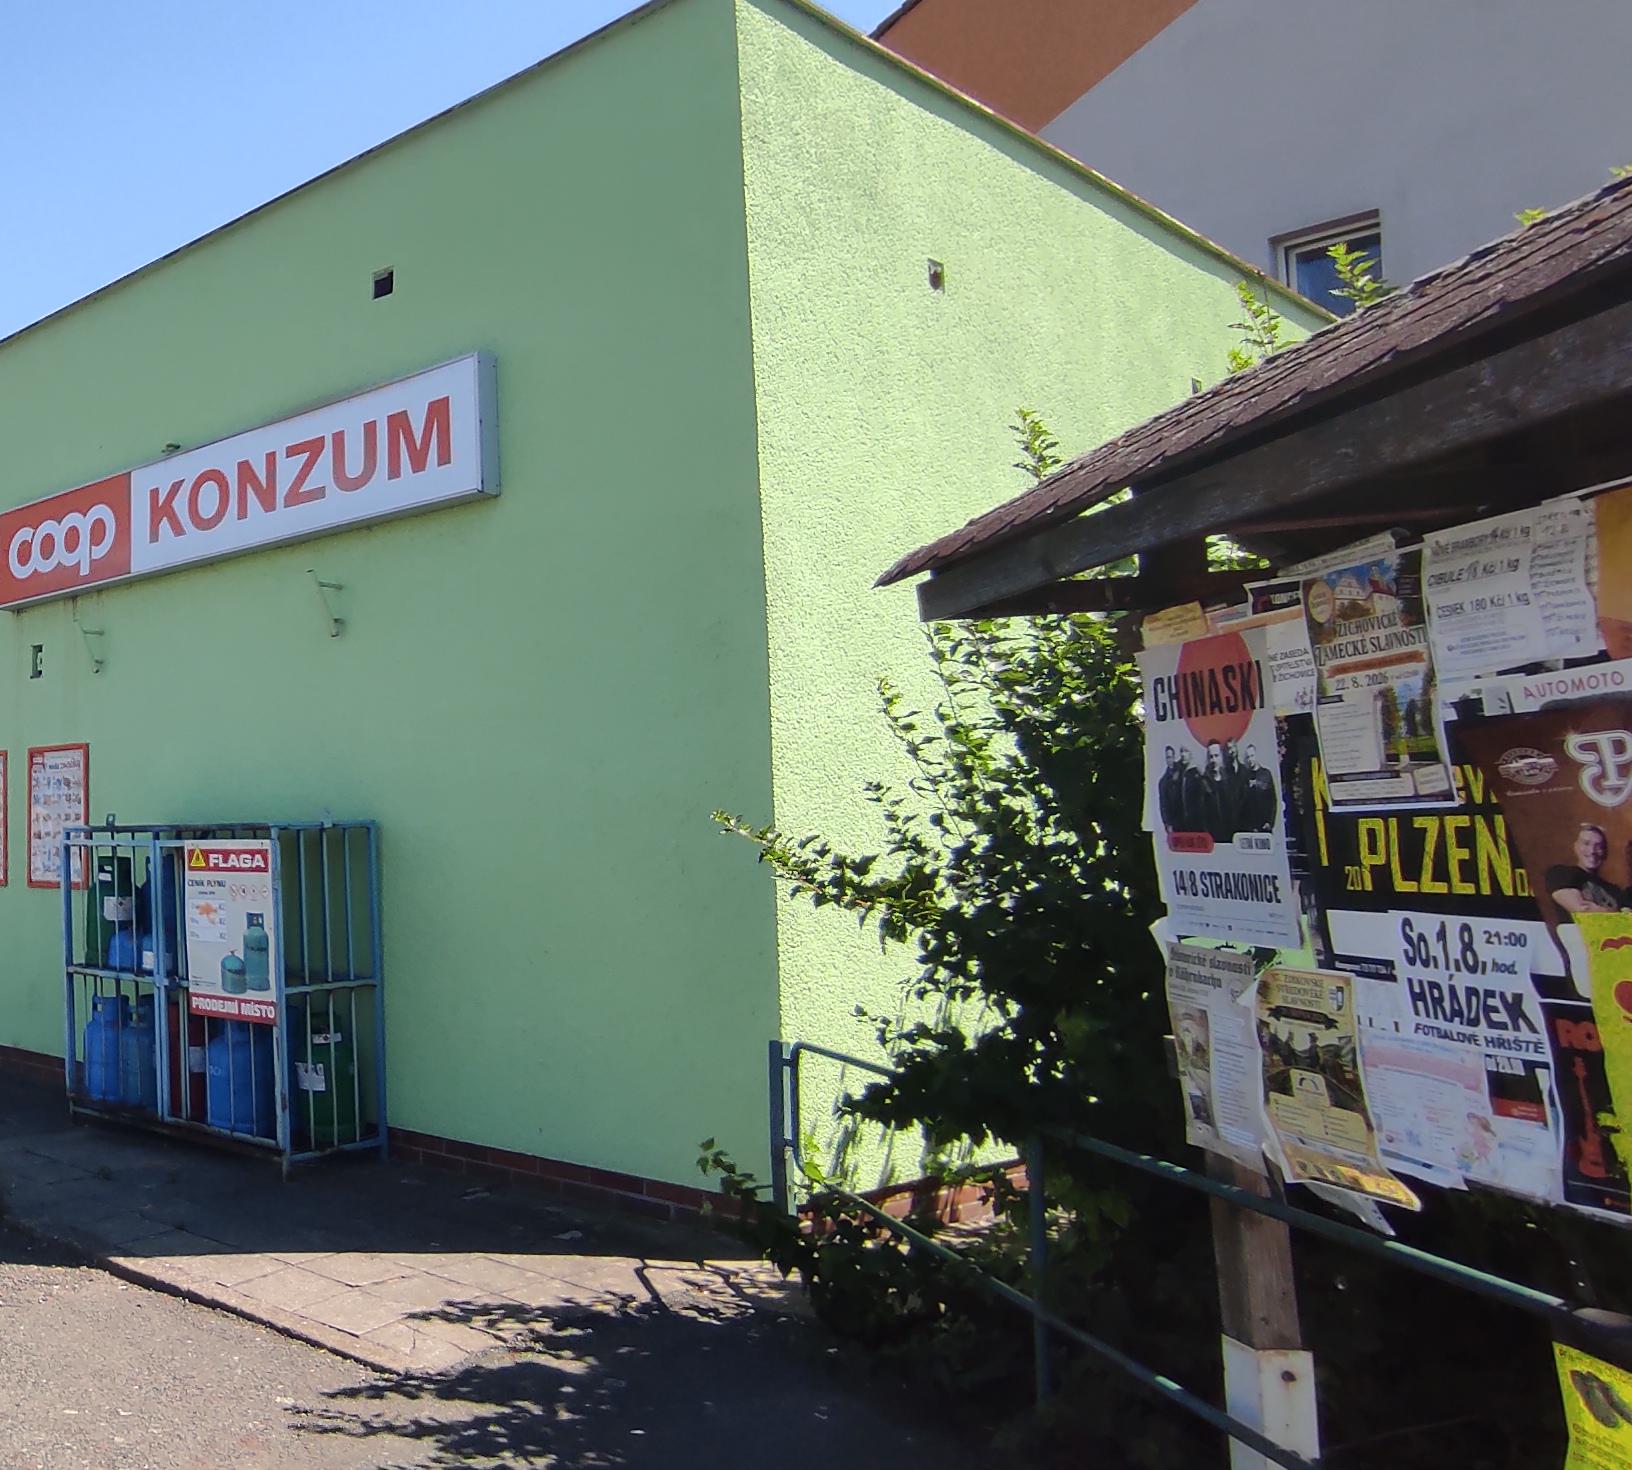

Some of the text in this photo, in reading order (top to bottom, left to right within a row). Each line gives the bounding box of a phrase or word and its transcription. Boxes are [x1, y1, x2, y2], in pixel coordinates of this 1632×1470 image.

[9, 396, 452, 579] coop KONZUM
[1507, 557, 1520, 572] kg
[1470, 598, 1487, 612] 180
[1516, 591, 1530, 606] kg
[1153, 660, 1265, 722] CHINASKI
[1523, 671, 1625, 700] AUTOMOTO
[208, 853, 266, 868] FLAGA
[1200, 871, 1282, 904] STRAKONICE
[1483, 930, 1527, 948] 21:00
[1491, 958, 1518, 975] hod.
[192, 996, 275, 1019] PRODEJNÍ MÍSTO
[1407, 974, 1540, 1034] HRÁDEK
[1414, 1023, 1481, 1046] FOTBALOVÉ
[1484, 1033, 1546, 1055] HŘIŠTĚ
